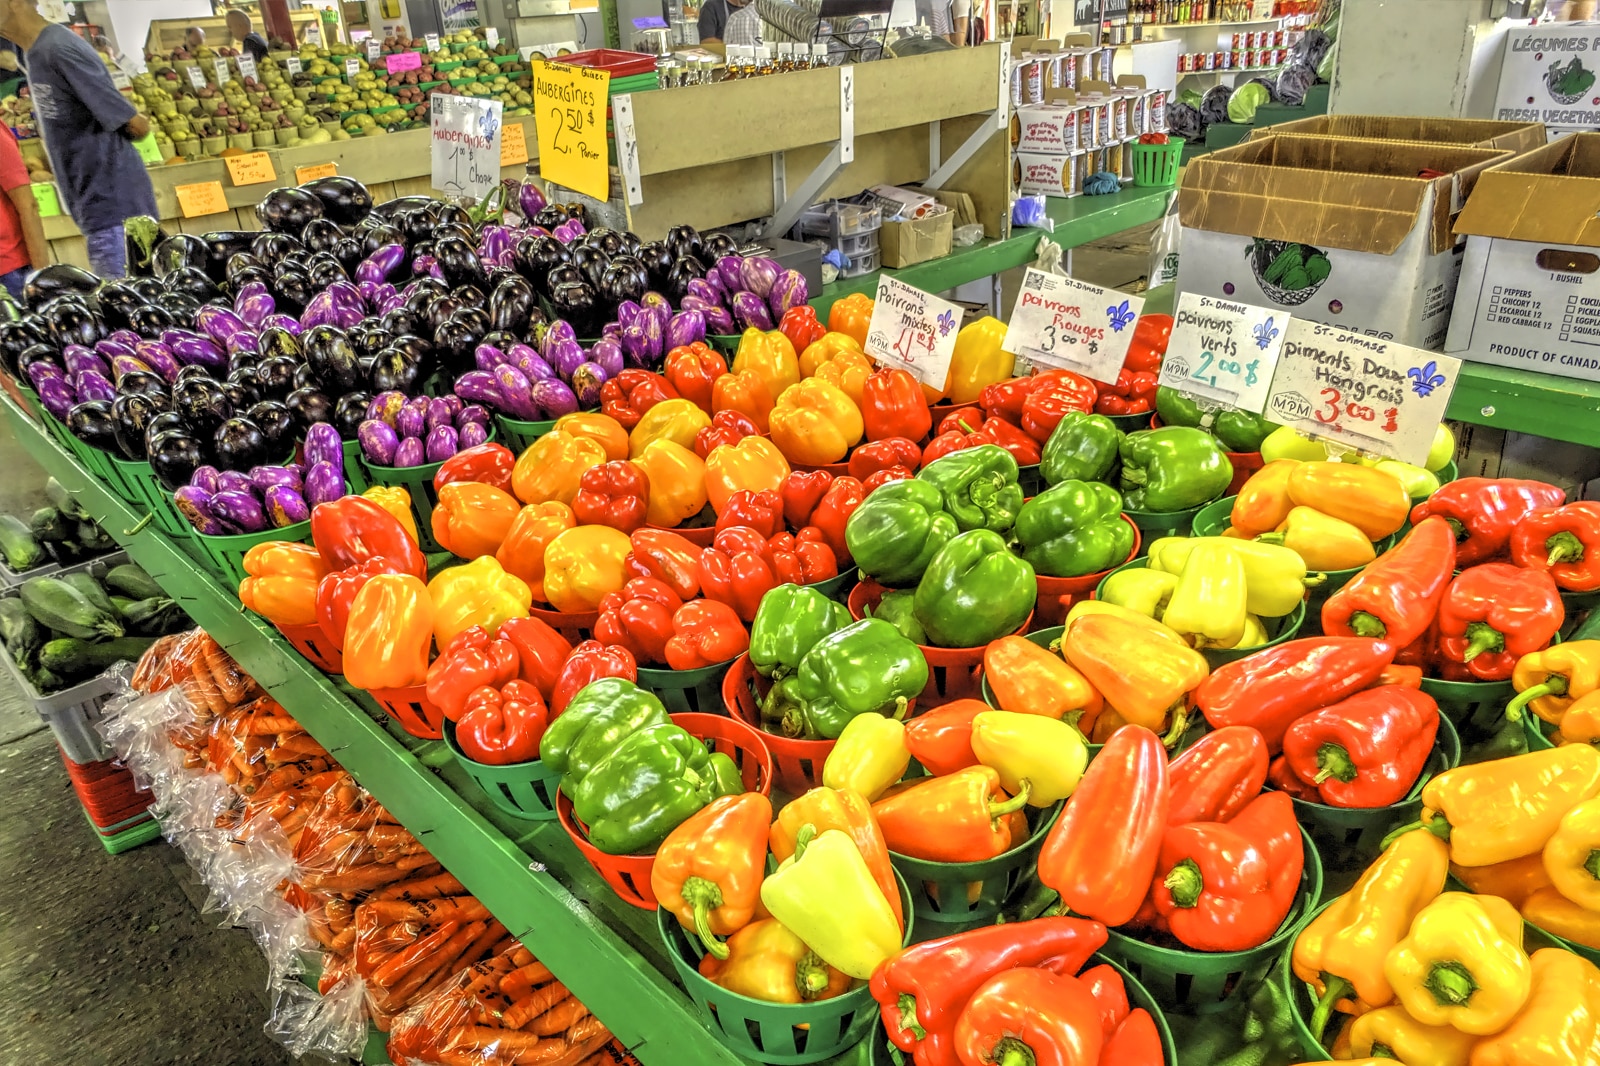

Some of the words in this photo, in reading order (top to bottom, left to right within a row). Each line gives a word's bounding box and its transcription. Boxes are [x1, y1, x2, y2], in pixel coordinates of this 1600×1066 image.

[1512, 35, 1588, 52] LÉGUMES
[1498, 108, 1540, 122] FRESH
[433, 119, 492, 150] Aubergines
[577, 141, 599, 160] Panier
[1556, 274, 1583, 284] BUSHEL
[878, 284, 924, 315] Poivrons
[1503, 288, 1532, 298] PEPPERS
[1022, 292, 1081, 318] poivrons
[1499, 306, 1532, 318] ESCAROLE
[1533, 310, 1542, 318] 12
[1501, 297, 1530, 308] CHICORY
[1532, 301, 1541, 309] 12
[901, 313, 932, 334] mixtes
[1053, 313, 1104, 344] Rouges
[1498, 315, 1511, 324] RED
[1511, 317, 1541, 328] CABBAGE
[1543, 321, 1553, 330] 12
[1088, 340, 1098, 355] $
[1489, 343, 1539, 360] PRODUCT
[1542, 352, 1557, 363] OF
[1560, 355, 1600, 370] CANAD
[1165, 362, 1188, 377] MPM
[1245, 359, 1260, 387] $
[1274, 396, 1310, 417] MPM
